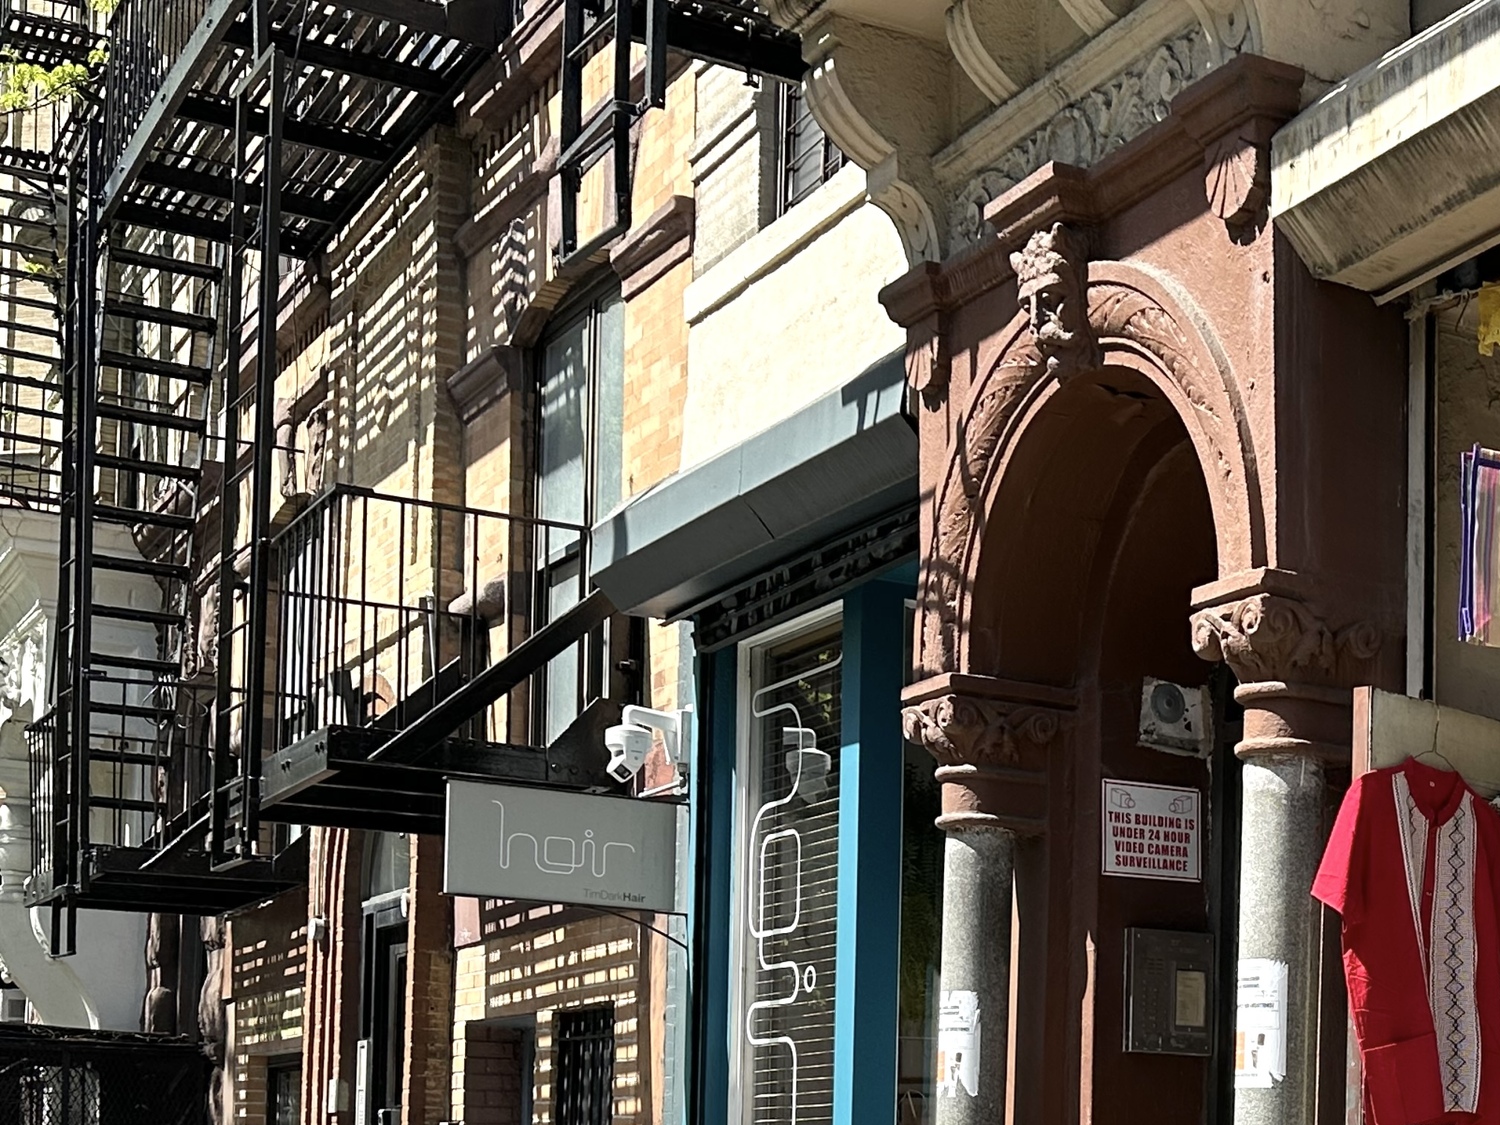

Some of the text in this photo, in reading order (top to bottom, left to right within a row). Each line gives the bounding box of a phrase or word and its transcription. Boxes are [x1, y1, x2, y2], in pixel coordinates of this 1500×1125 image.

[1108, 811, 1195, 830] THIS BUILDING IS
[492, 800, 636, 878] hair
[1112, 826, 1191, 844] UNDER 24 HOUR
[1114, 840, 1188, 857] VIDEO CAMERA
[1115, 855, 1188, 872] SURVEILLANCE
[583, 888, 646, 903] TimDarkHair
